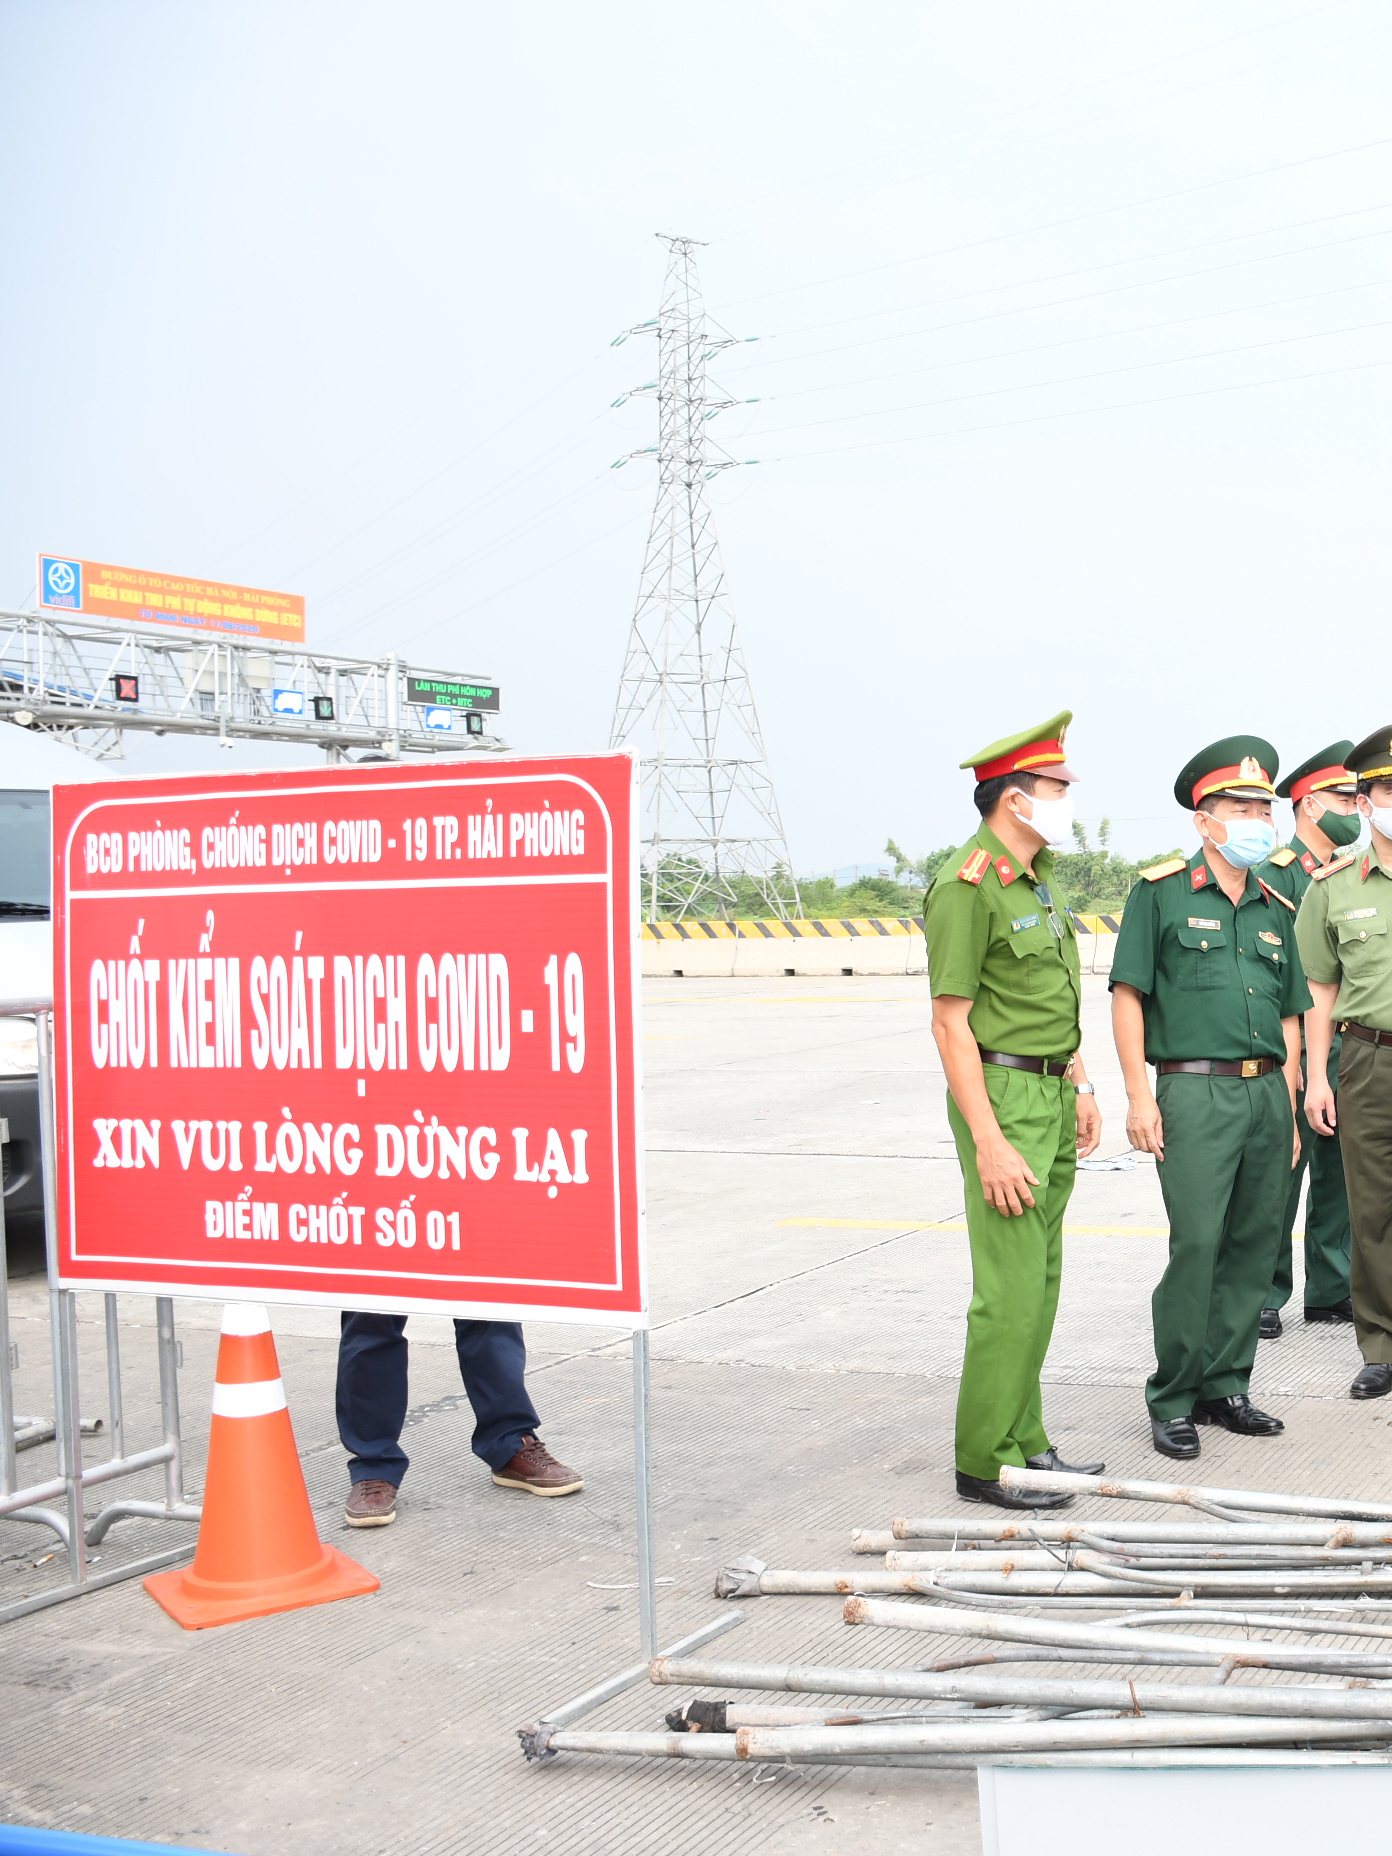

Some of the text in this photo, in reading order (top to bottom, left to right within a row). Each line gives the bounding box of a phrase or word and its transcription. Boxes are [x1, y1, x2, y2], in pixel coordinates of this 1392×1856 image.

[87, 581, 118, 601] TRIỂN
[119, 588, 143, 605] KHAI
[144, 591, 163, 608] THU
[165, 594, 182, 611] PHÍ
[183, 597, 196, 615] TỰ
[197, 598, 222, 617] ĐỘNG
[223, 603, 253, 620] KHÔNG
[280, 612, 302, 629] (ETC)
[138, 574, 147, 586] Ô
[163, 579, 184, 591] CAO
[185, 582, 204, 595] TỐC
[206, 585, 219, 597] HÀ
[221, 588, 238, 600] NỘI
[261, 594, 291, 608] PHÒNG
[181, 615, 206, 626] NGÀY
[415, 680, 431, 692] LÀN
[431, 682, 447, 693] THU
[477, 688, 493, 700] HỢP
[436, 695, 452, 705] ETC
[457, 697, 473, 707] MTC
[86, 797, 585, 877] BCĐ PHÒNG, CHỐNG DỊCH COVID - 19 TP. HẢI PHÒNG
[89, 908, 586, 1098] CHỐT KIỂM SOÁT DỊCH COVID - 19
[92, 1105, 590, 1200] XIN VUI LÒNG DỪNG LẠI
[204, 1184, 461, 1252] ĐIỂM CHỐT SỐ 01
